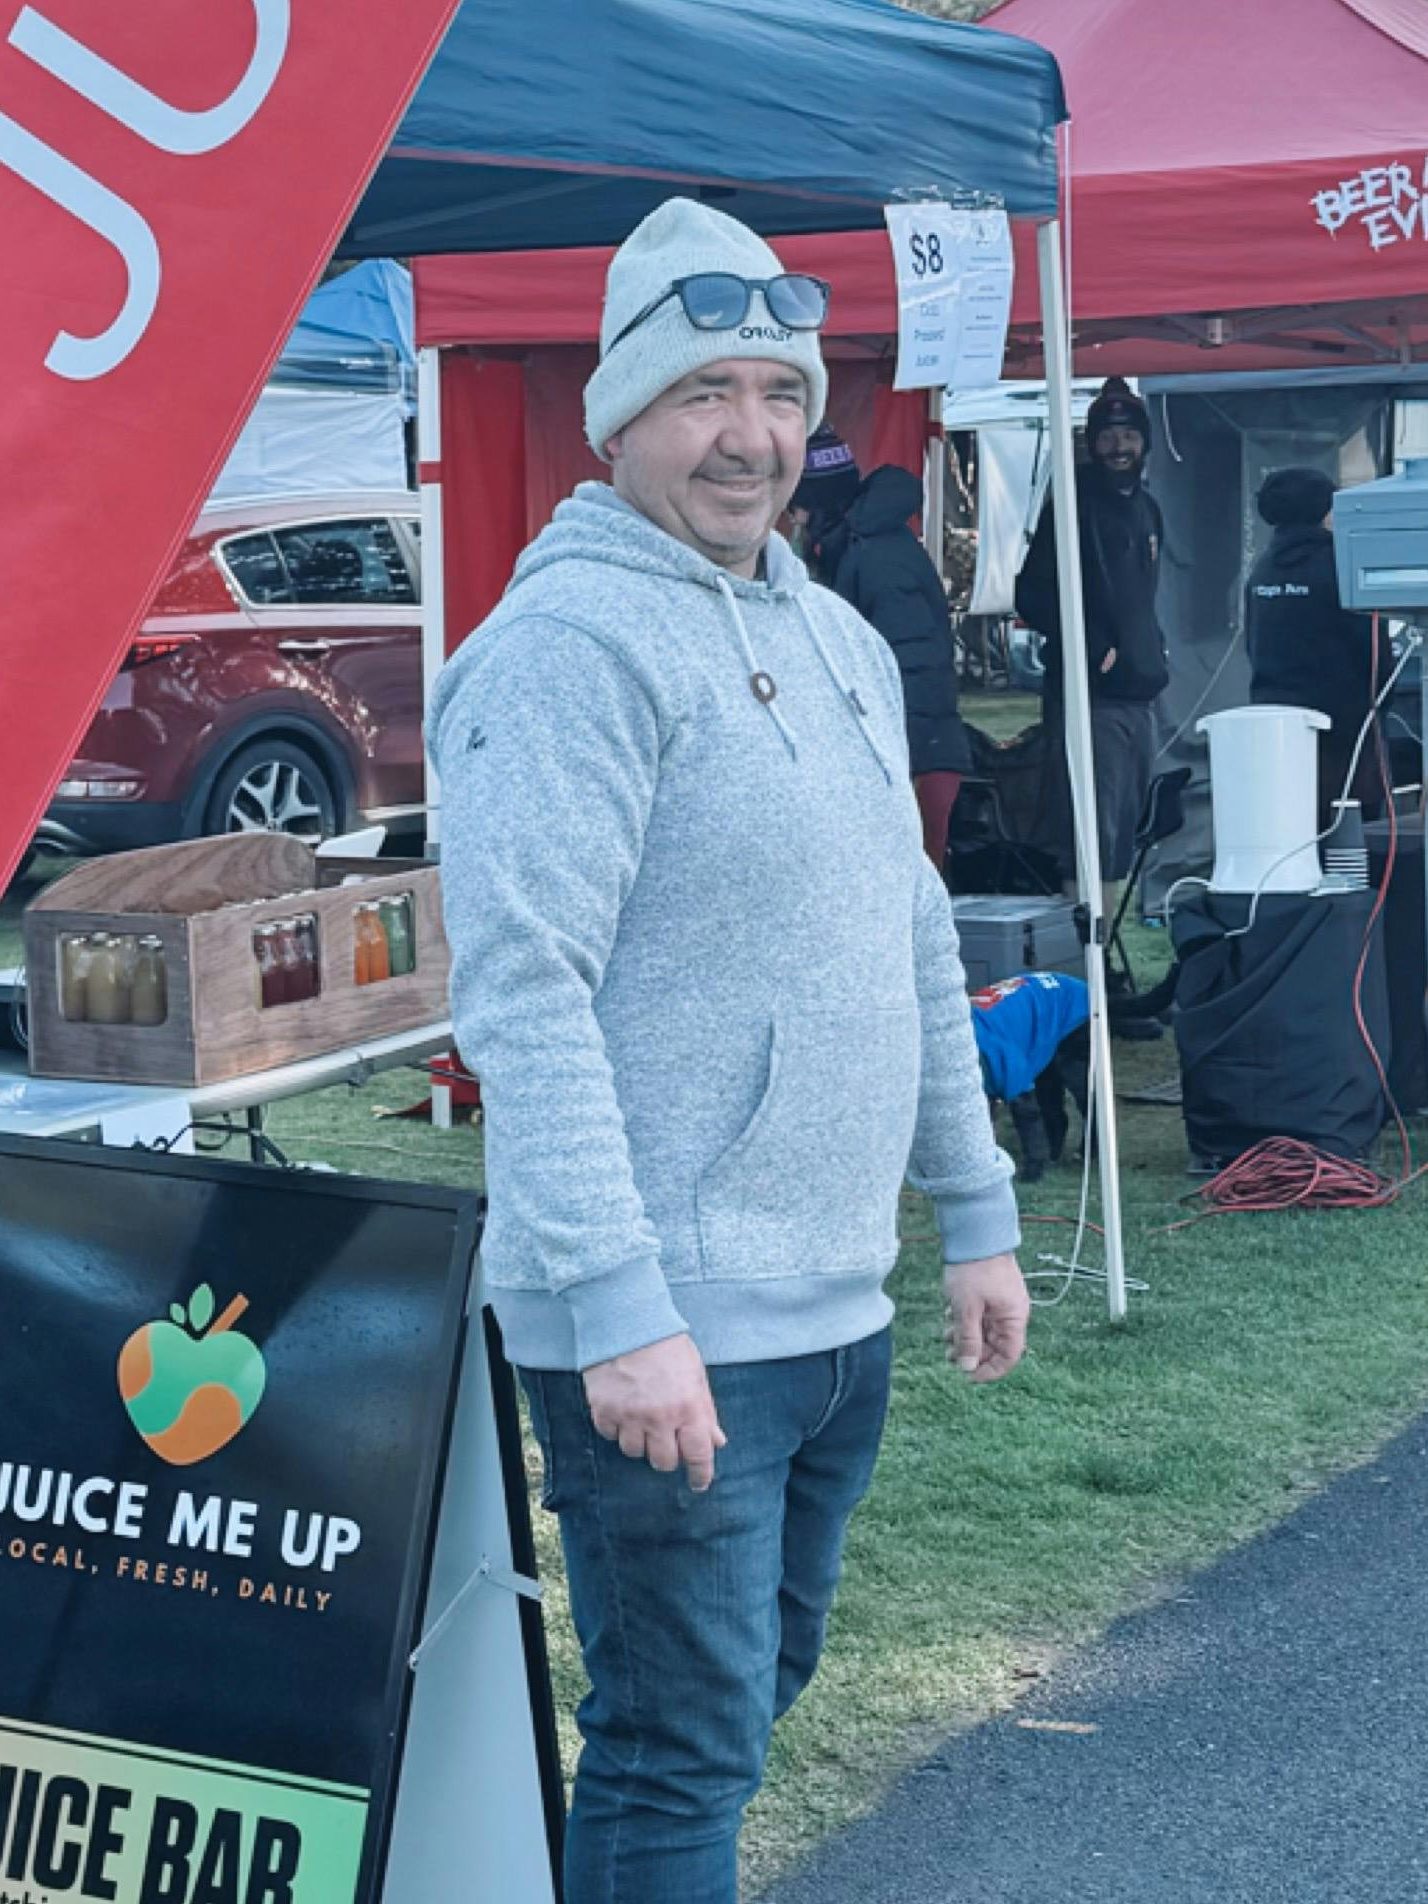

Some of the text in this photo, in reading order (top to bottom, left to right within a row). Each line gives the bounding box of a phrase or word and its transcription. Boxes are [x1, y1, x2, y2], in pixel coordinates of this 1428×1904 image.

[1309, 162, 1420, 241] BEER
[909, 228, 944, 280] $8
[167, 1491, 258, 1558] ME
[281, 1509, 361, 1572] UP
[116, 1556, 220, 1598] FRESH,
[239, 1577, 332, 1611] DAILY
